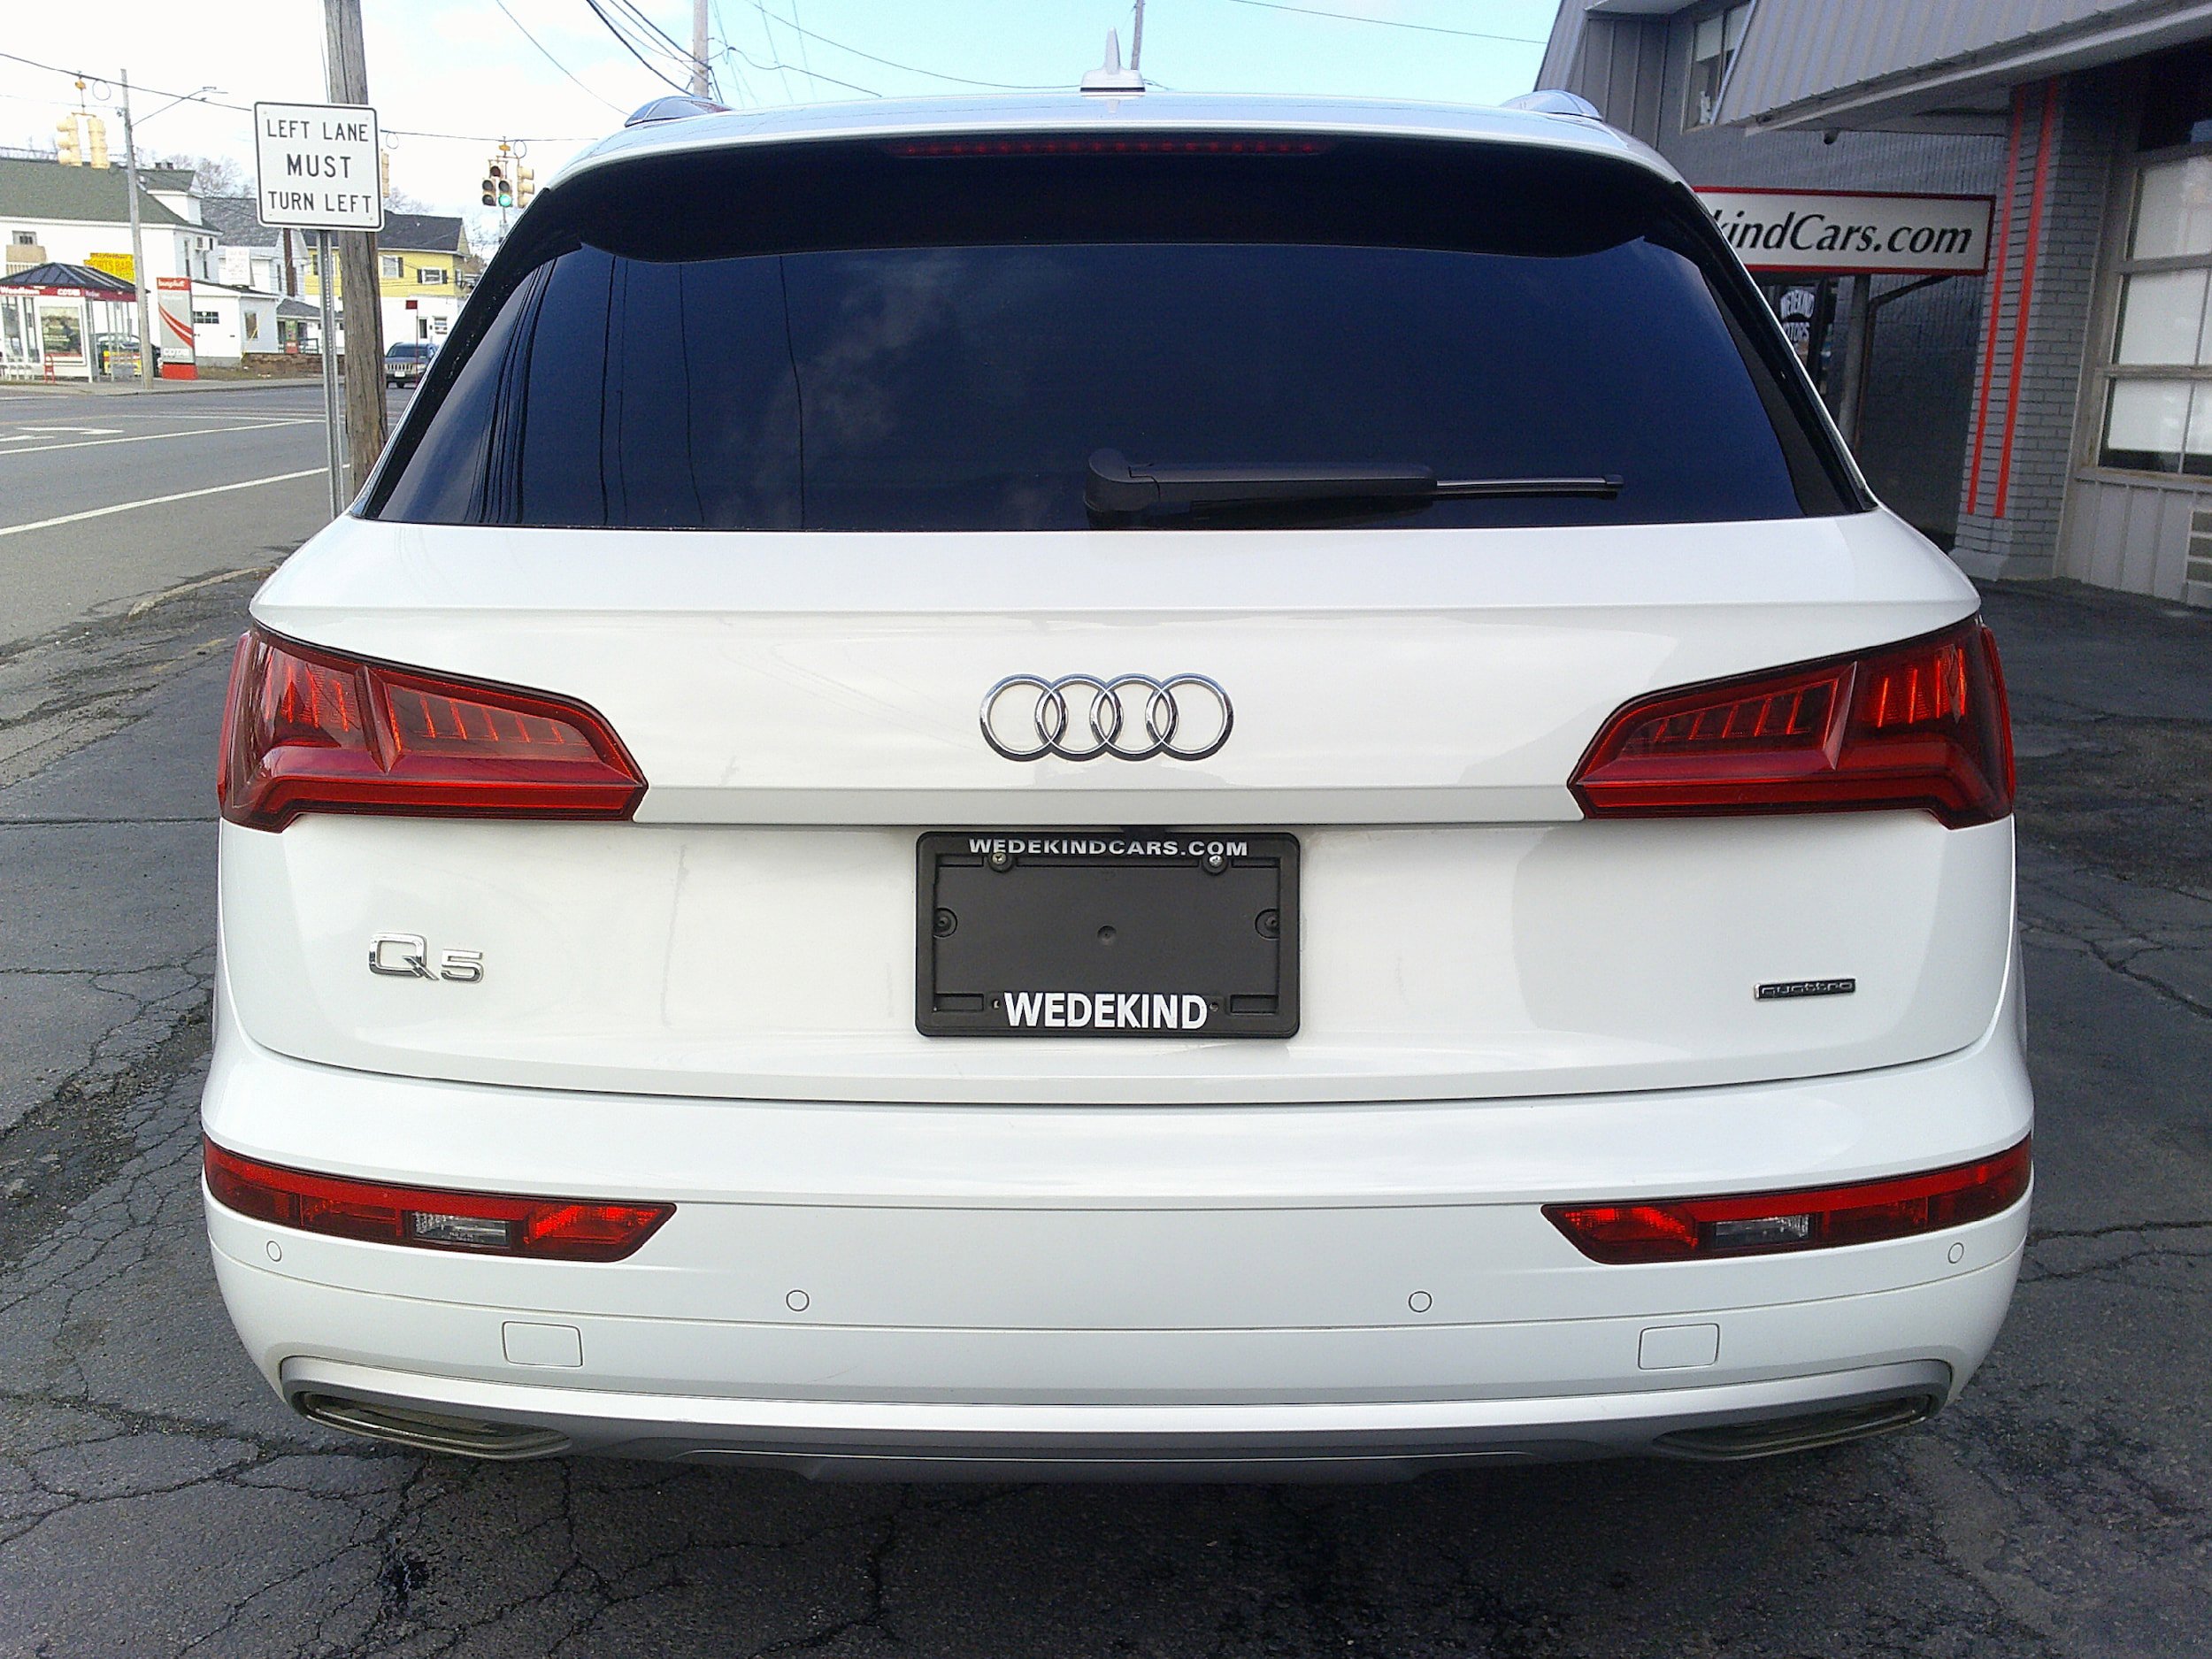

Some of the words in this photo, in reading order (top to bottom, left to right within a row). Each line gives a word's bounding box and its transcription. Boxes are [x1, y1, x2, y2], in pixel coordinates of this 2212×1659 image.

[267, 119, 310, 139] LEFT
[323, 122, 368, 142] LANE
[287, 153, 351, 178] MUST
[268, 191, 314, 211] TURN
[325, 194, 372, 213] LEFT
[969, 839, 1248, 856] WEDEKINDCARS.COM
[369, 932, 484, 984] Q5
[1761, 981, 1853, 996] quattro
[1003, 992, 1209, 1030] WEDEKIND
